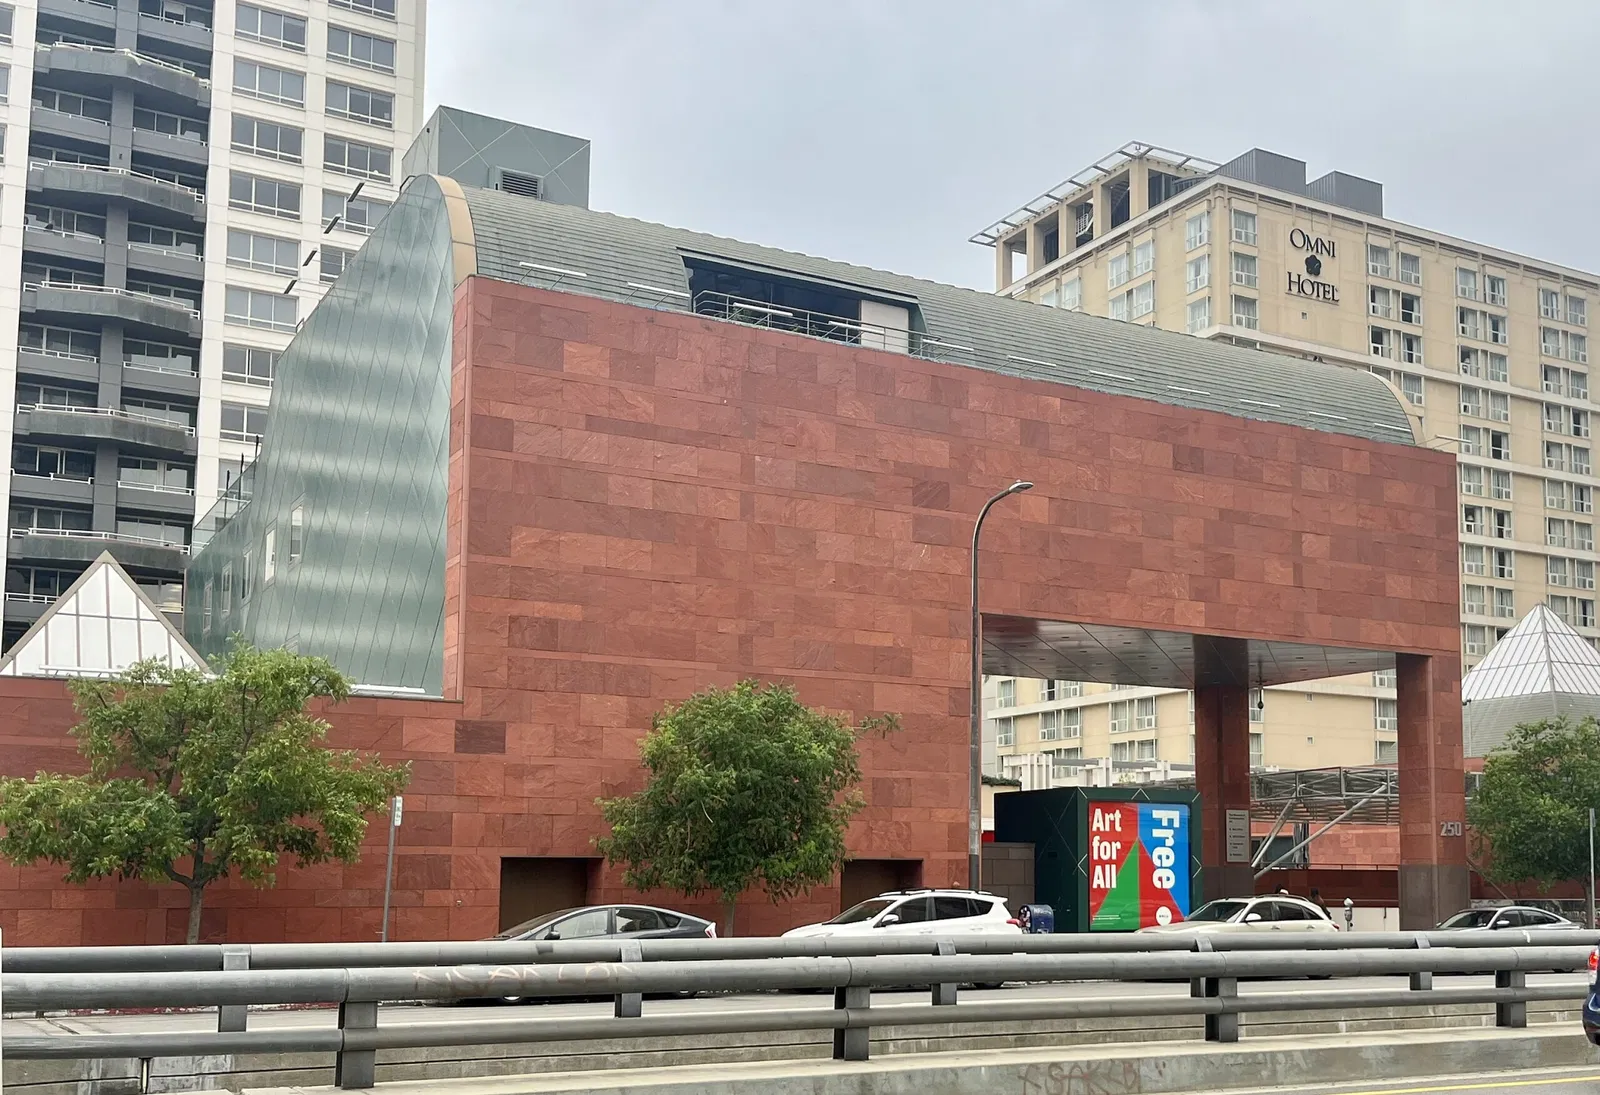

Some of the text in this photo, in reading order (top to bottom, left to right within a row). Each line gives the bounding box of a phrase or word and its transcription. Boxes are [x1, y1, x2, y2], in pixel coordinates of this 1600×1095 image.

[1289, 228, 1336, 258] OMNI
[1286, 271, 1340, 302] HOTEL
[1091, 808, 1122, 832] Art
[1440, 821, 1462, 837] 250
[1092, 835, 1122, 860] for
[1151, 809, 1180, 889] Free
[1092, 864, 1117, 889] All
